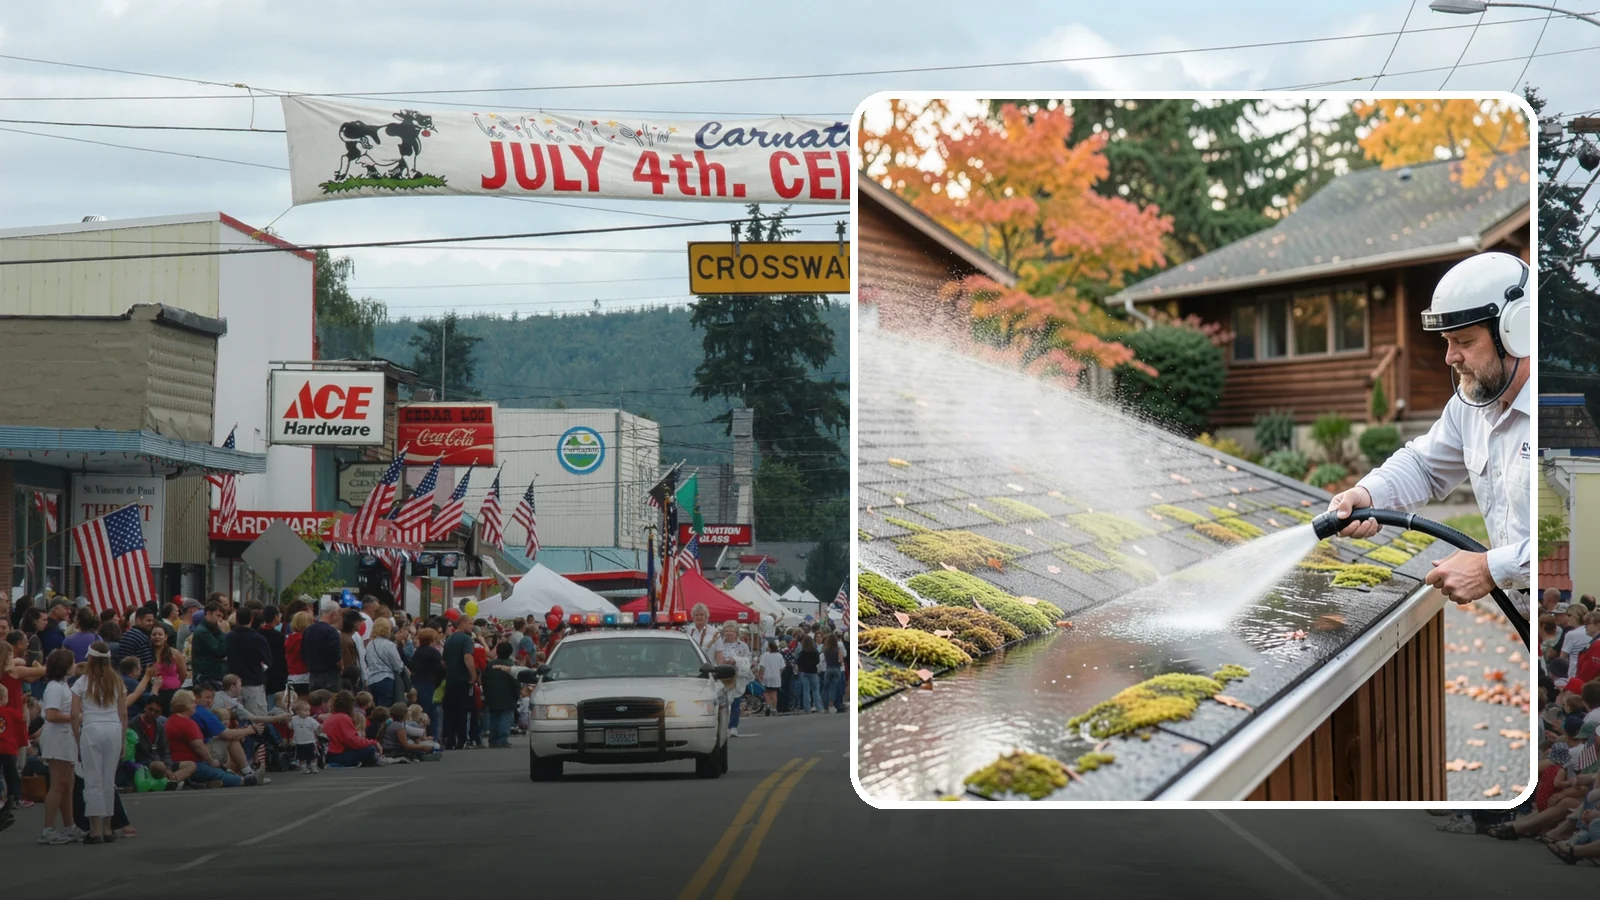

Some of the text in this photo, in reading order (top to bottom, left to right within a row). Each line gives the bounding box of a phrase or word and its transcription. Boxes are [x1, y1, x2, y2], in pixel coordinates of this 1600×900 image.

[481, 140, 605, 192] JULY
[632, 150, 746, 198] 4th.
[697, 253, 850, 280] CROSSWA
[283, 379, 374, 420] ACE
[406, 408, 485, 422] CEDAR LOG
[283, 421, 371, 437] Hardware
[416, 427, 477, 447] Coca-Cola
[96, 485, 124, 495] Vincent
[126, 485, 136, 495] de
[137, 486, 155, 496] Paul
[688, 526, 741, 535] CRNATION
[699, 535, 730, 543] GLASS
